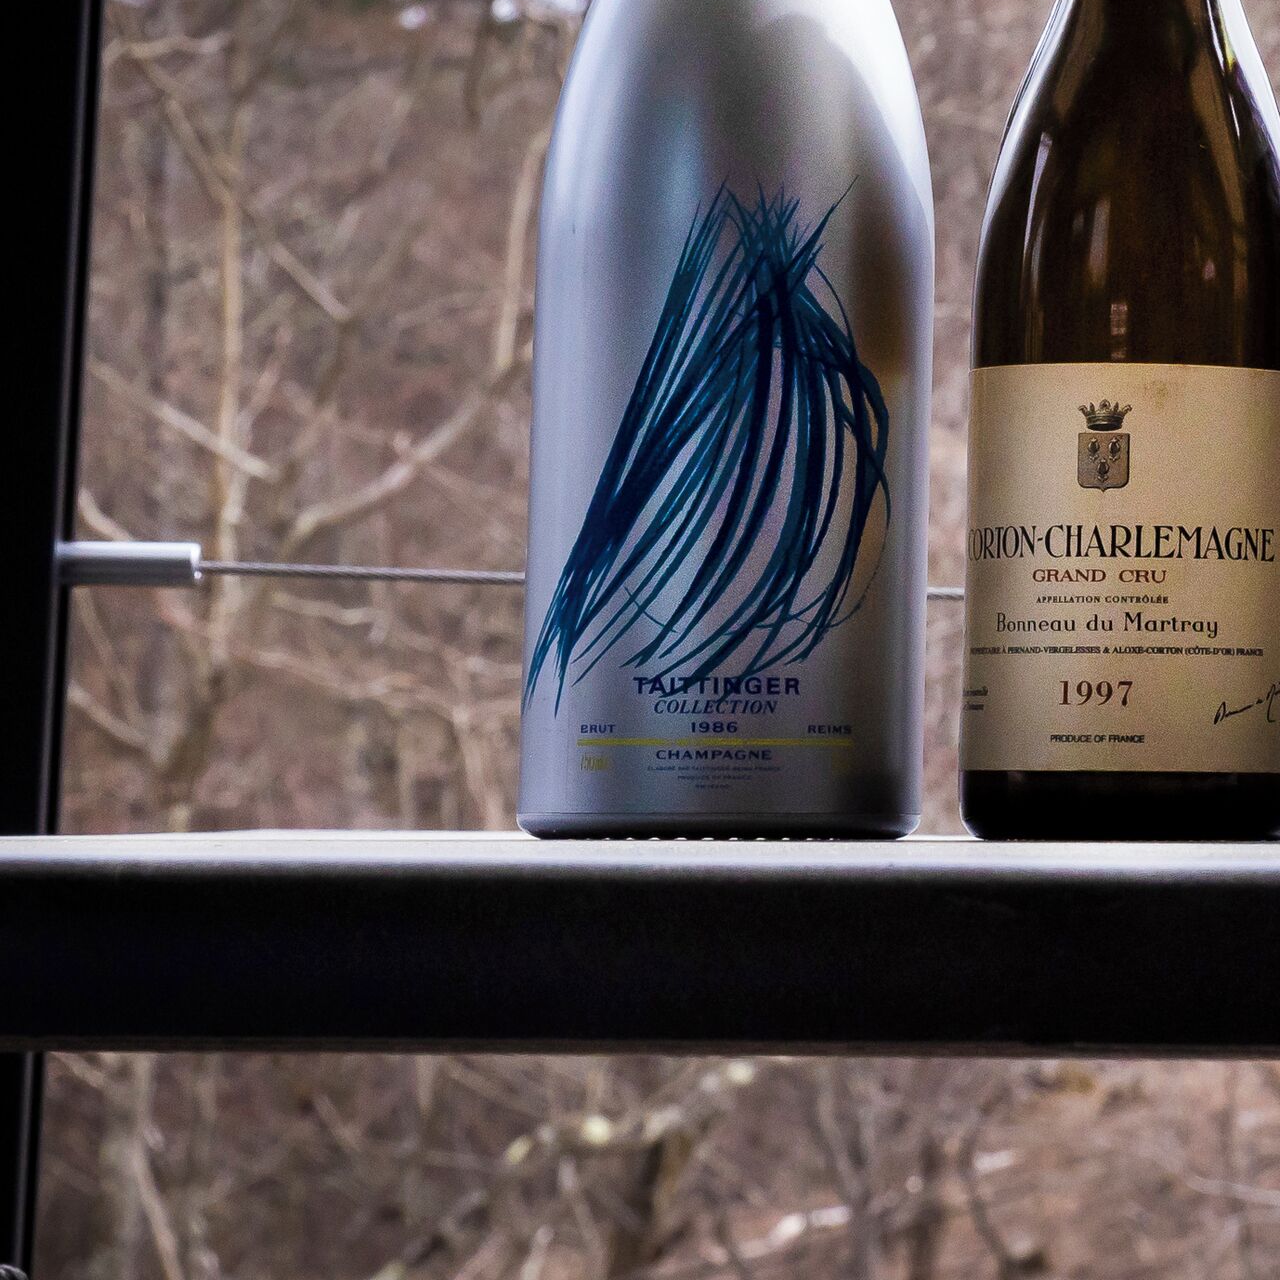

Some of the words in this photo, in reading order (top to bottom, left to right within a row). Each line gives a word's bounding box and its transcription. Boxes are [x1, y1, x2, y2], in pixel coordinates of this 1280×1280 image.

[968, 524, 1275, 562] CORTON-CHARLEMAGNE
[1032, 569, 1107, 583] GRAND
[1119, 569, 1167, 583] CRU
[1036, 595, 1101, 604] APPELLATION
[1105, 594, 1169, 604] CONTRÔLÉE
[996, 612, 1076, 632] Bonneau
[1086, 614, 1114, 632] du
[1124, 611, 1218, 639] Martray
[1103, 646, 1110, 654] &
[1112, 646, 1183, 656] ALOXE-CORTON
[1236, 648, 1264, 657] FRANCE
[633, 676, 801, 696] TAITTINGER
[1059, 680, 1134, 708] 1997
[653, 699, 778, 715] COLLECTION
[580, 724, 617, 734] BRUT
[690, 721, 739, 734] 1986
[807, 724, 852, 735] REIMS
[1050, 734, 1093, 744] PRODUCE
[1094, 734, 1107, 744] OF
[1108, 734, 1145, 744] FRANCE
[655, 749, 773, 761] CHAMPAGNE
